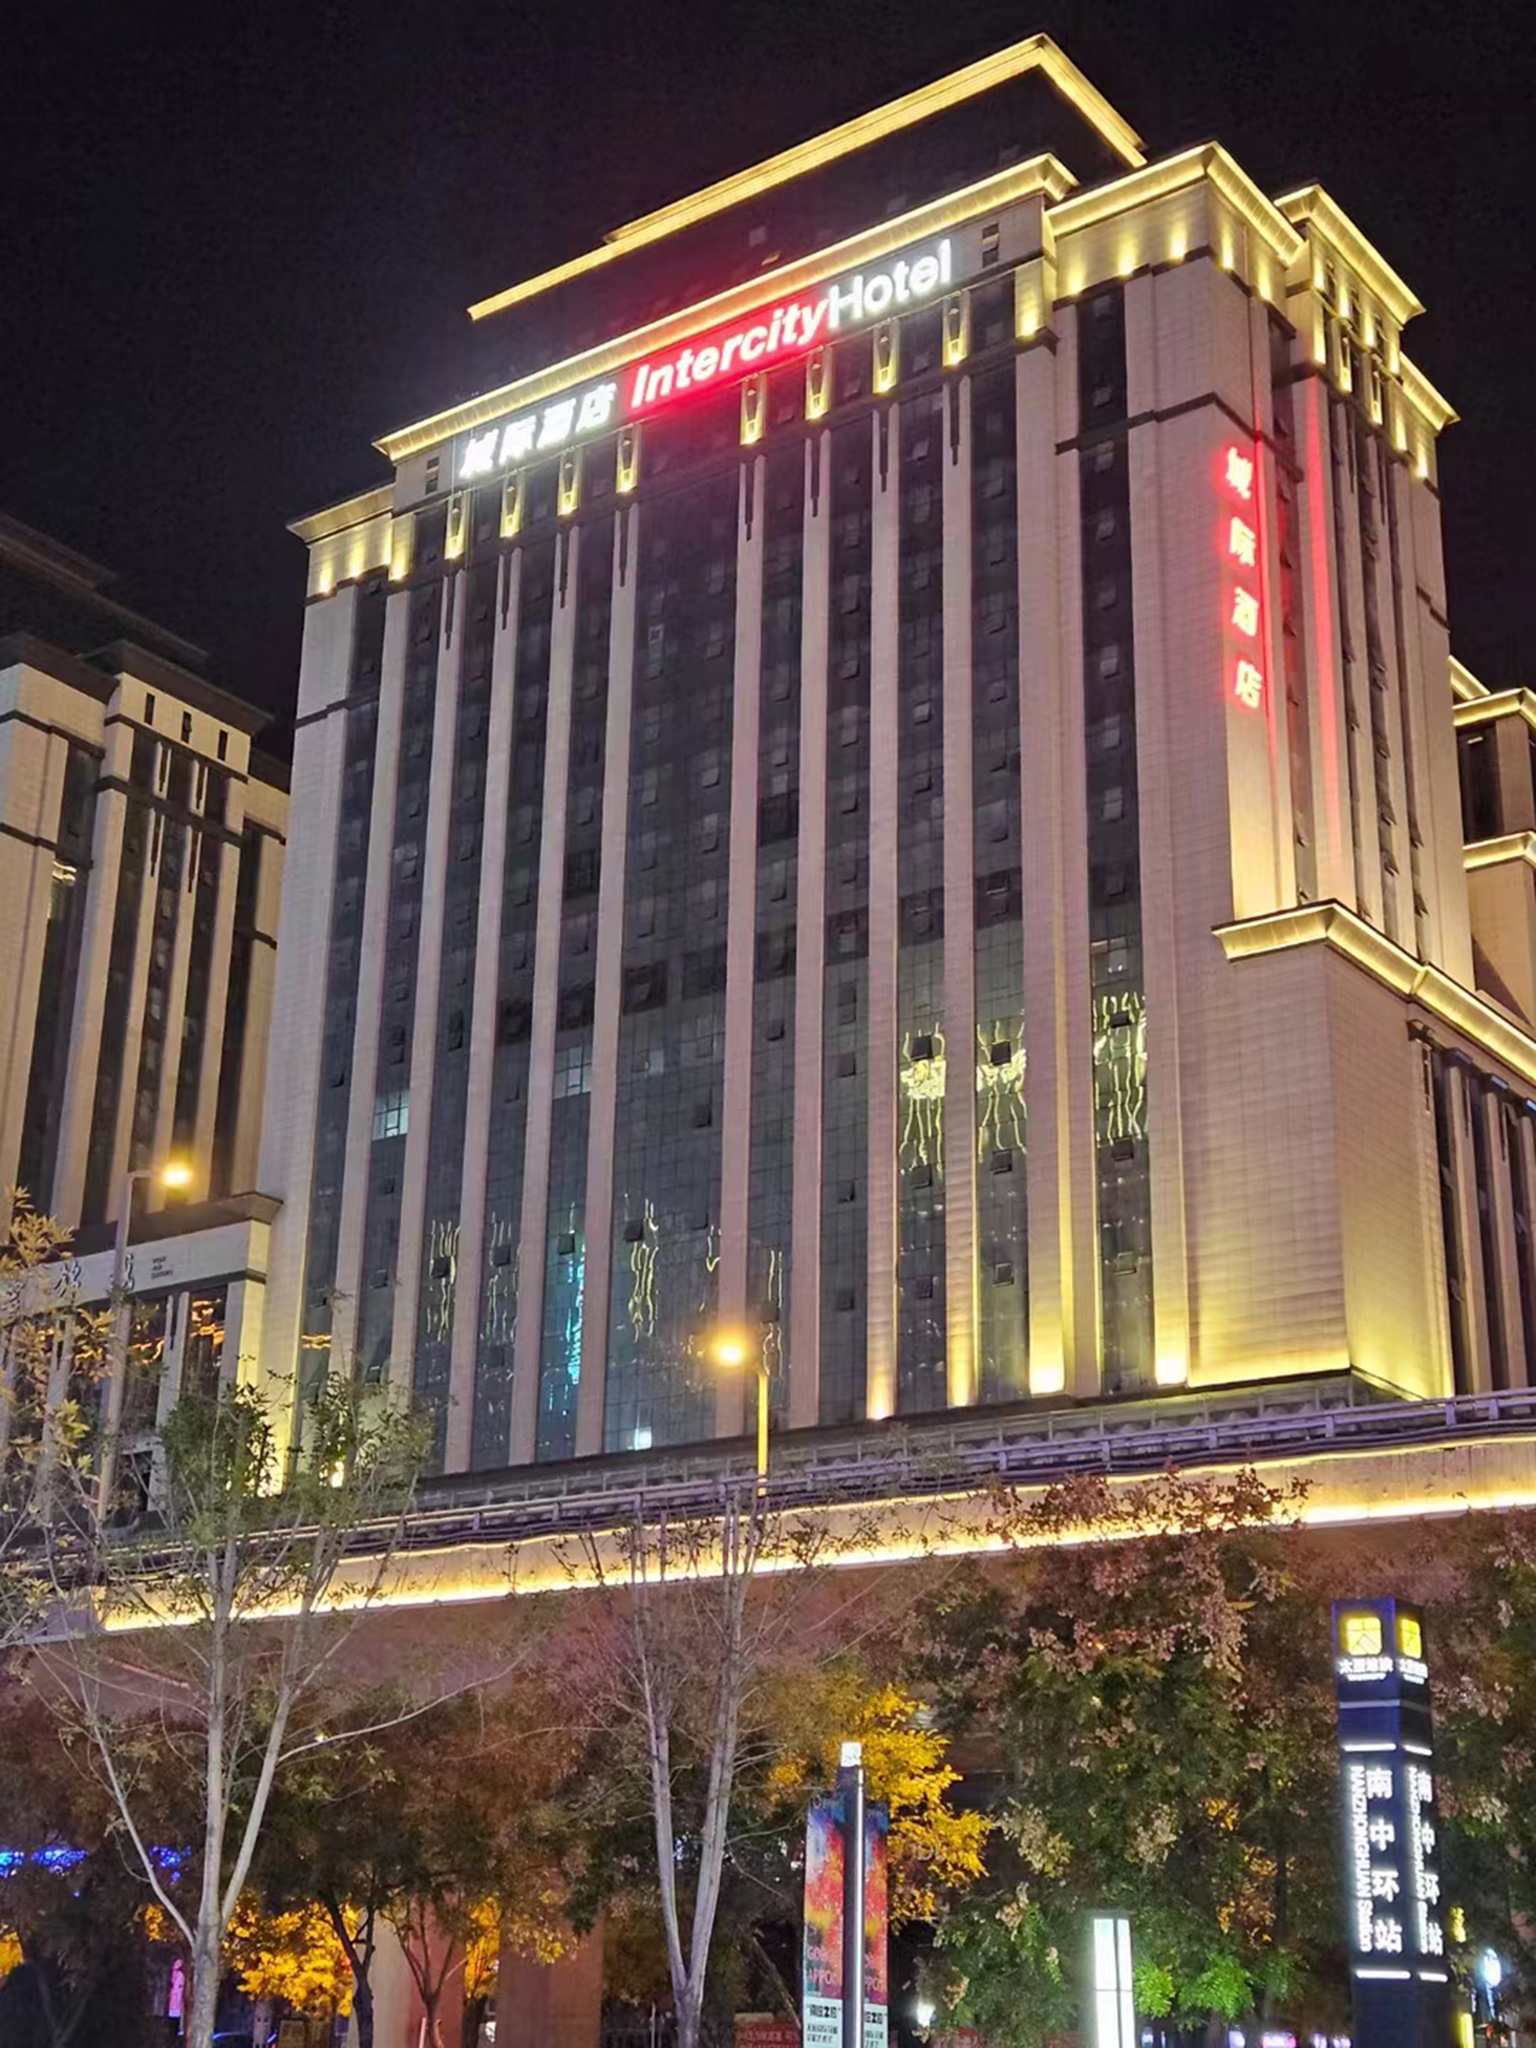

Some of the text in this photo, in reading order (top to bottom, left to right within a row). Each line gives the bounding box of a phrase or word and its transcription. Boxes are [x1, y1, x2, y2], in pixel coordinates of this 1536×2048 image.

[631, 238, 951, 408] IntercityHotel
[1350, 1765, 1373, 1952] NANZHONGHUAN Station
[1366, 1767, 1402, 1953] 南中环站
[1418, 1771, 1443, 1955] 南中环站
